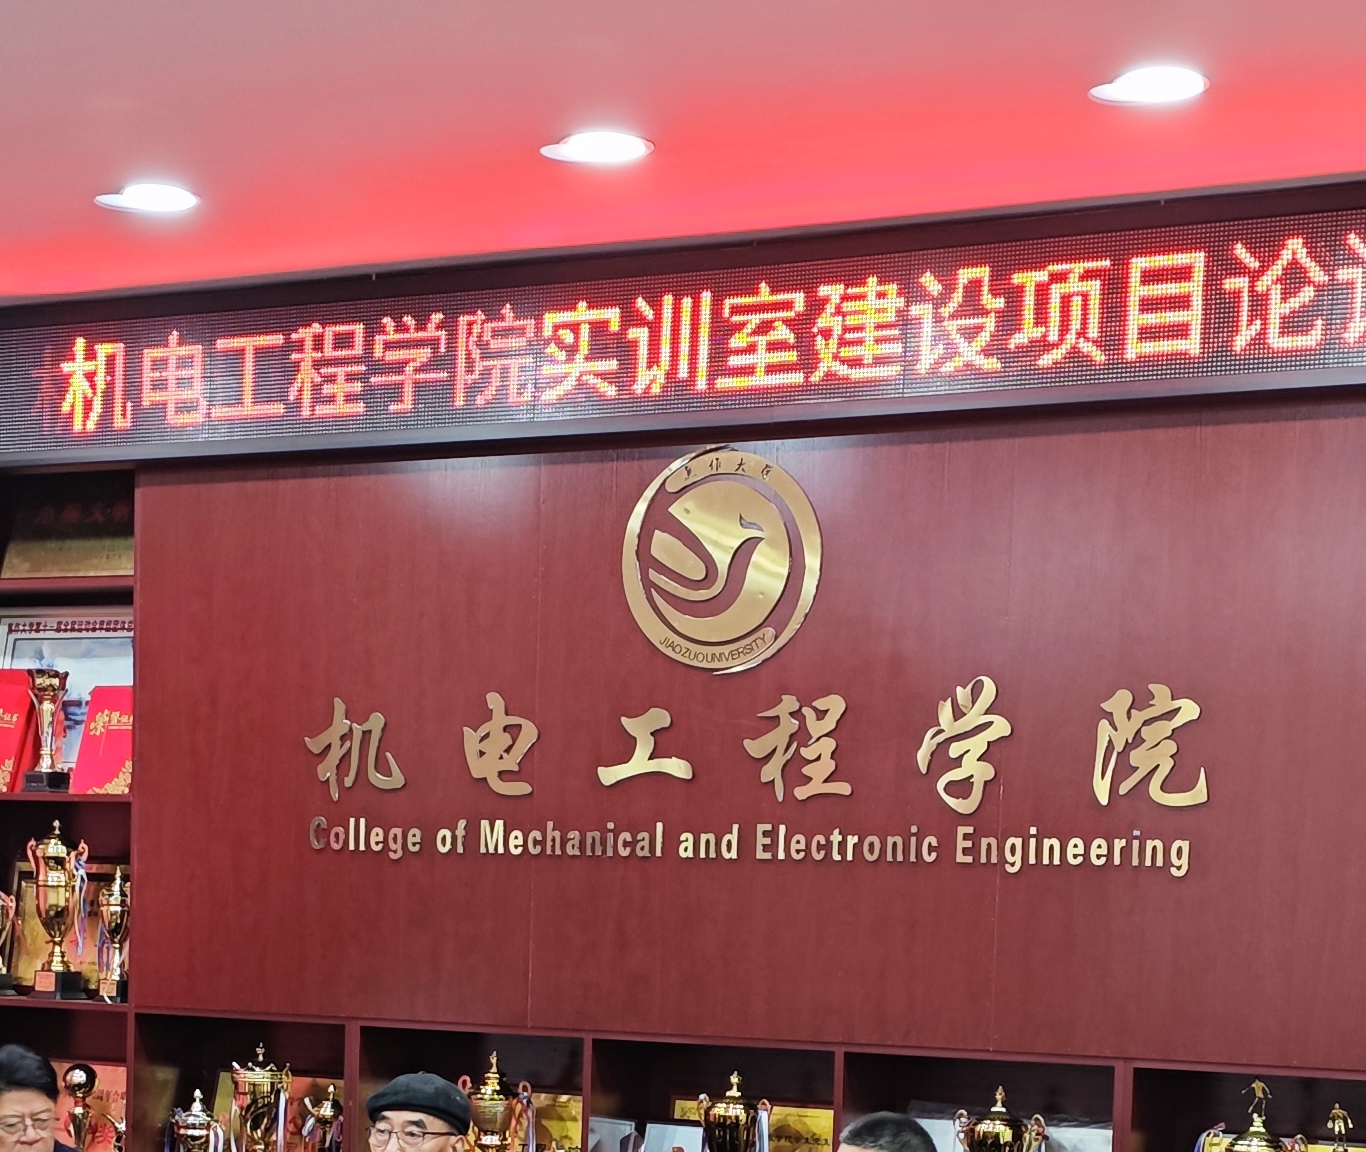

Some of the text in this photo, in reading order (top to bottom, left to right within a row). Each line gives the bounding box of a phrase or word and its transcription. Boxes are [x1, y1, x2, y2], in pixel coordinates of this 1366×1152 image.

[303, 674, 1209, 815] 机电工程学院
[309, 815, 1191, 877] College of Mechanical and Electronic Engineering
